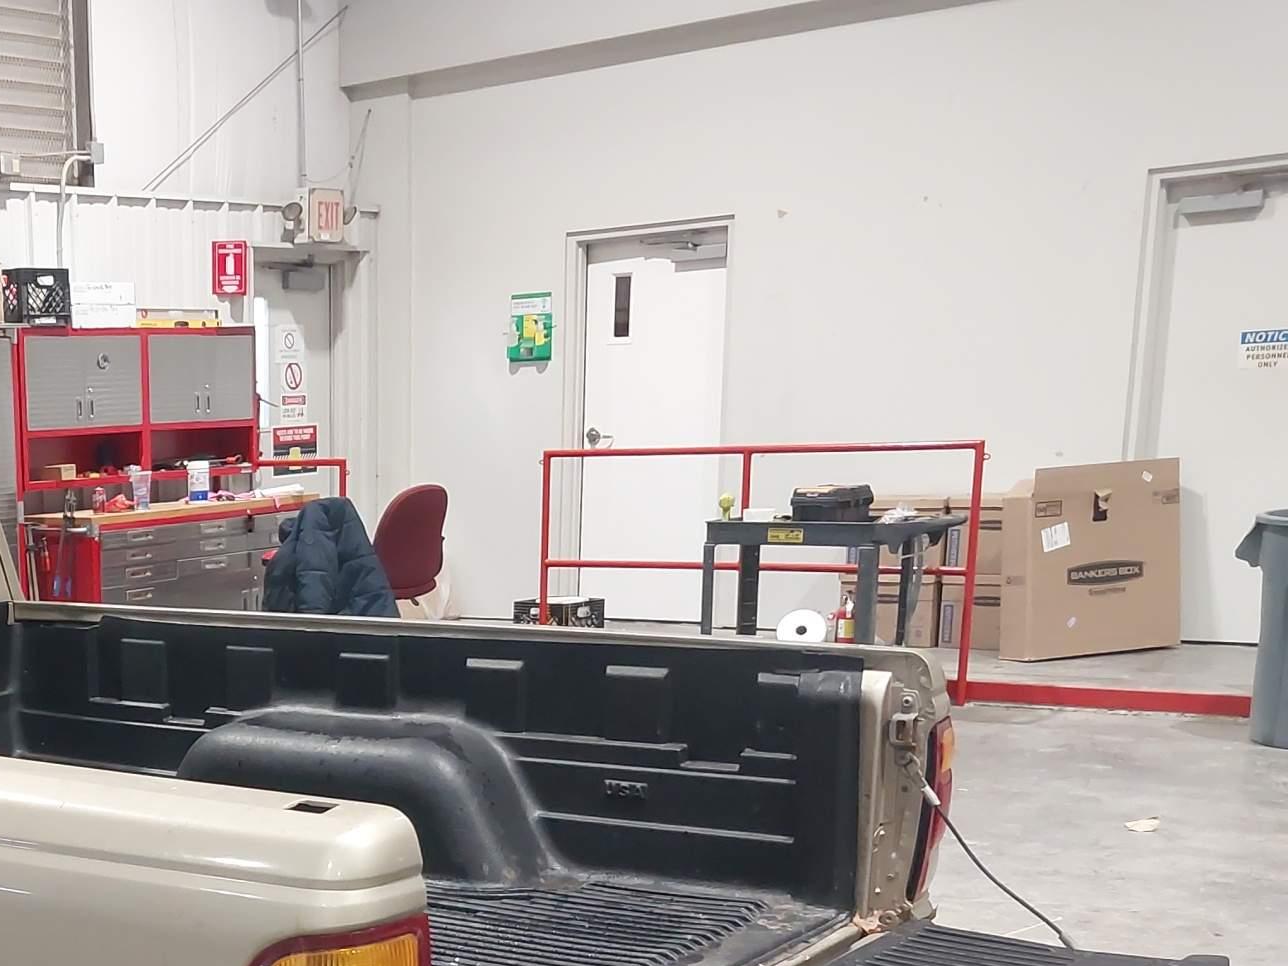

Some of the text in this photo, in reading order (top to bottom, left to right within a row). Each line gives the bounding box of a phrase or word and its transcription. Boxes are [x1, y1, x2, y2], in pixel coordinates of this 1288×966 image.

[318, 201, 340, 230] EXIT
[1245, 331, 1288, 343] NOTIC
[1246, 344, 1288, 352] AUTHORIZE
[1247, 352, 1288, 361] PERSONNE
[1070, 566, 1140, 580] BANKERS BOX
[603, 779, 648, 799] USA
